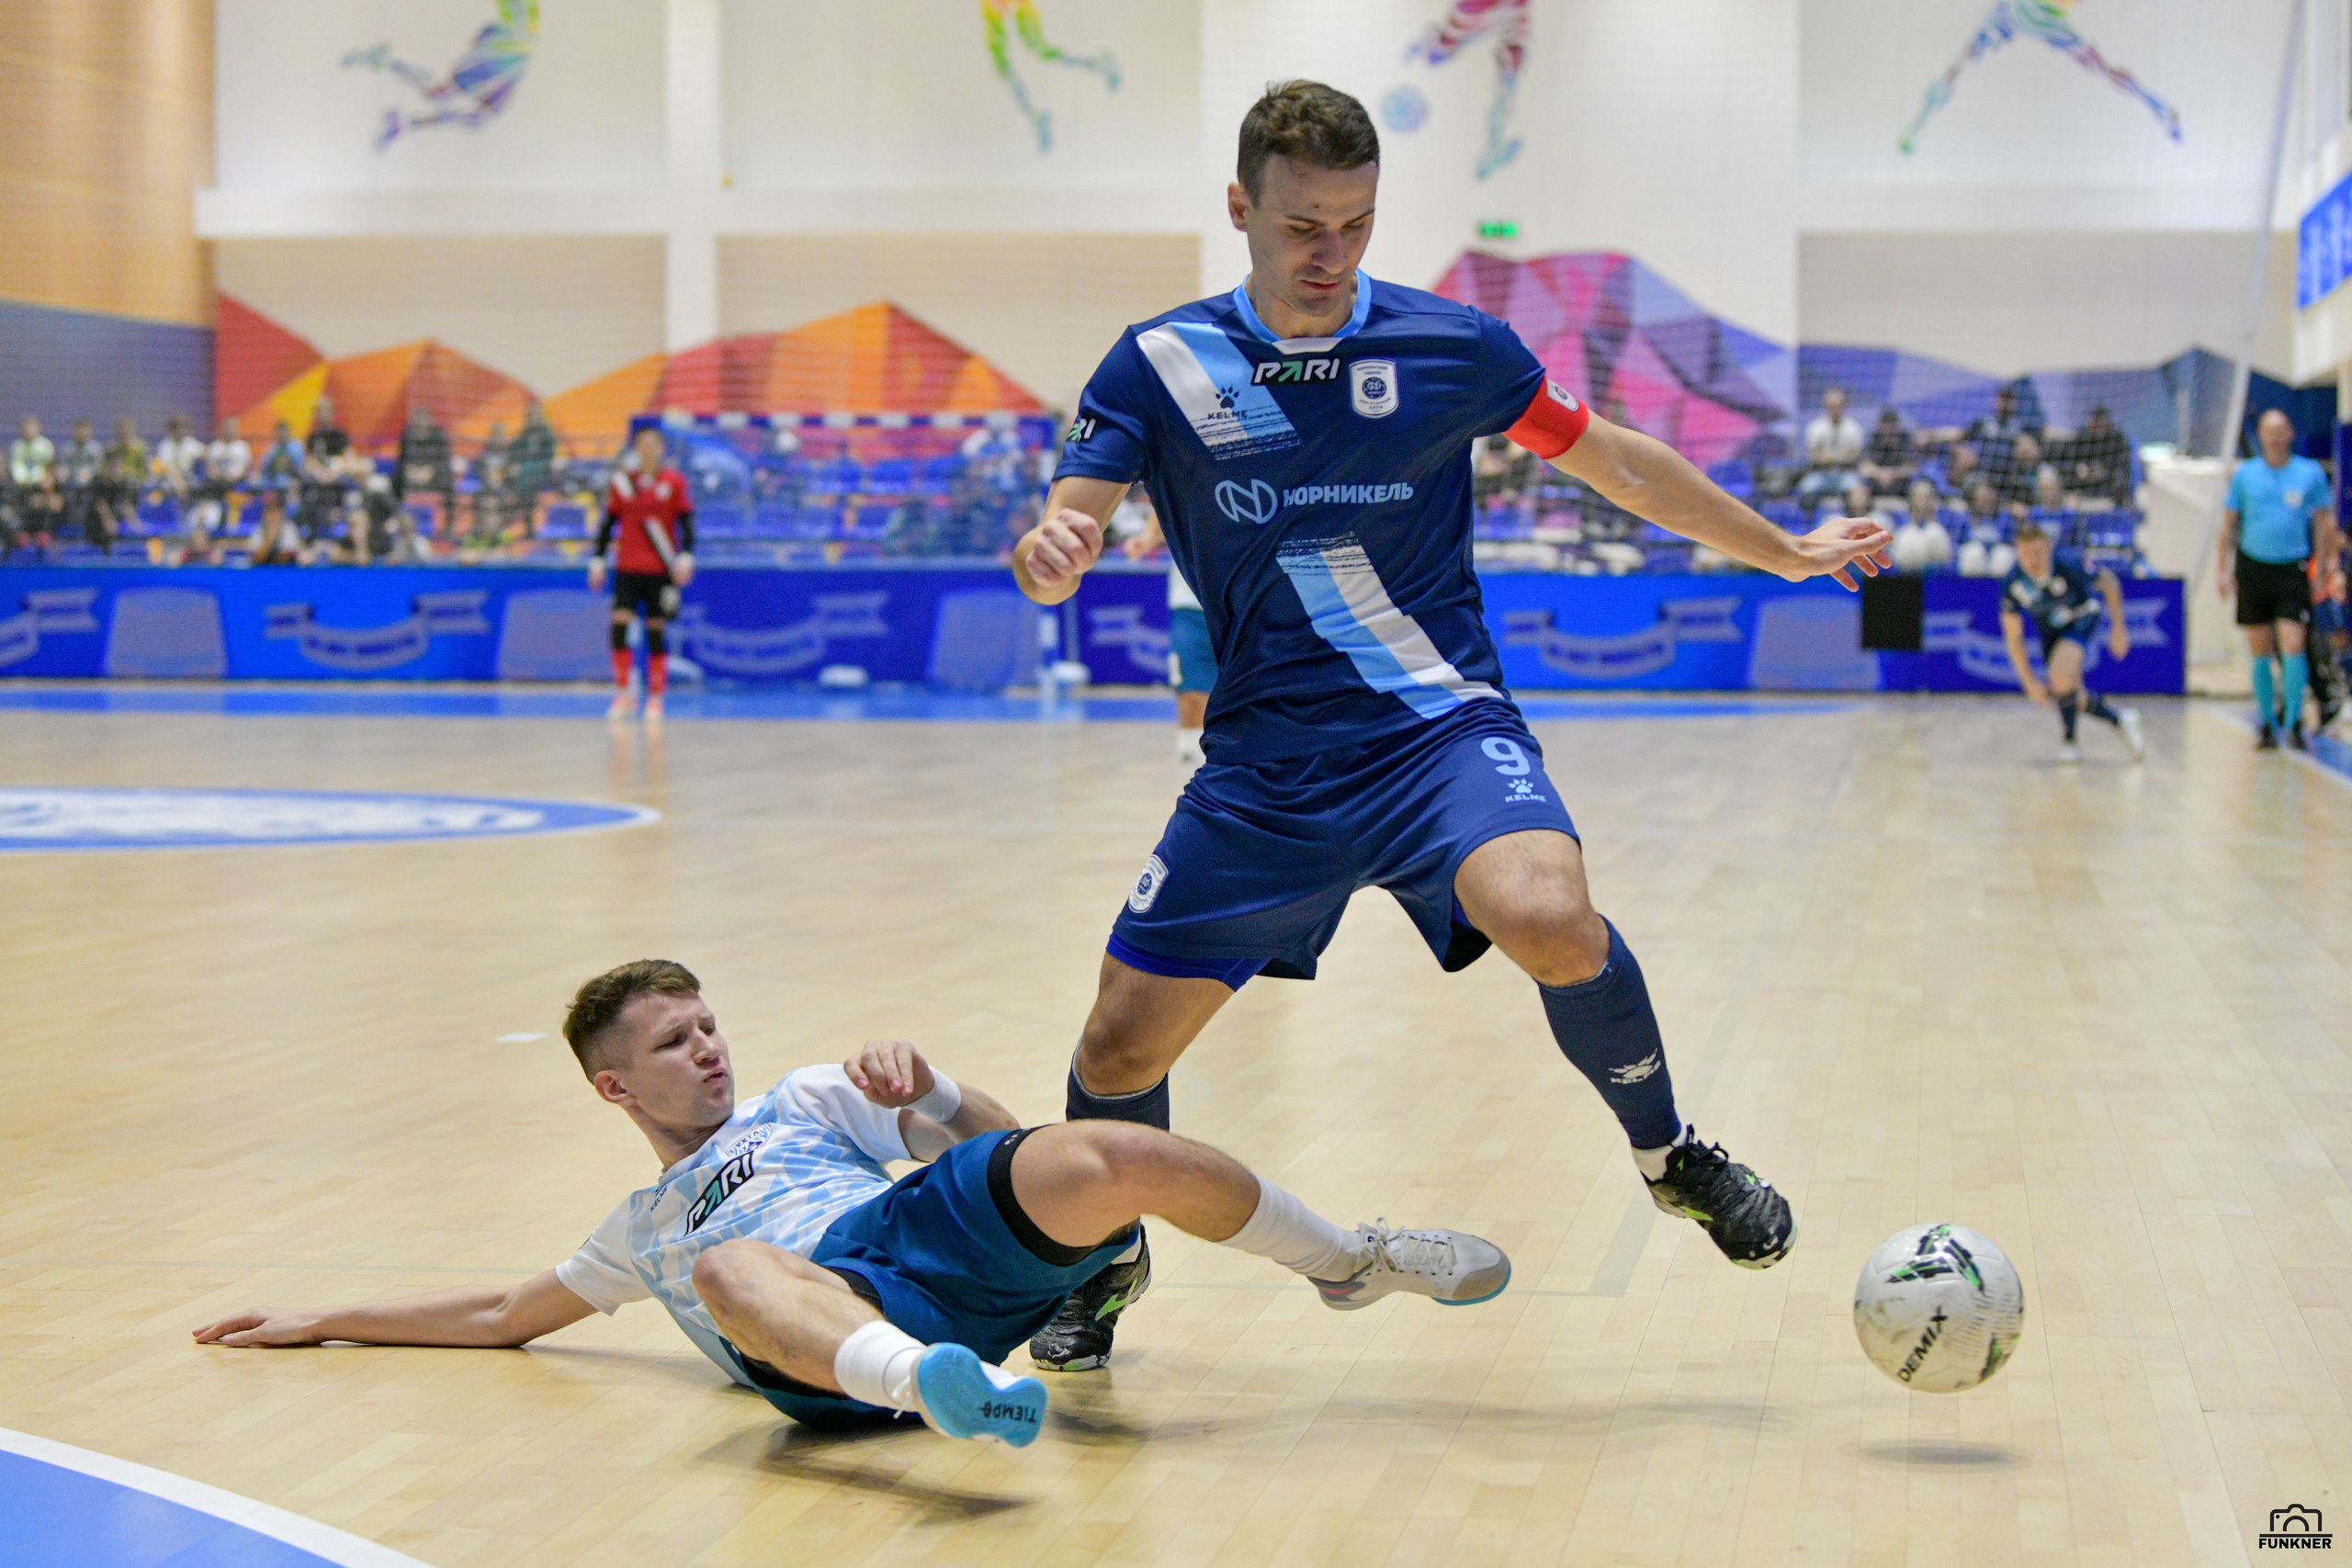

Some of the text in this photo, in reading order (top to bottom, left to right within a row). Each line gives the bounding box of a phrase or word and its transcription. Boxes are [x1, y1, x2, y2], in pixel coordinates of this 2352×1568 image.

[1253, 357, 1341, 385] PARI
[1207, 410, 1248, 420] KELME
[1283, 481, 1414, 507] НОРНИКЕЛЬ
[1480, 736, 1531, 776] 9
[1505, 794, 1546, 803] KELME
[686, 1154, 753, 1234] PARI
[1897, 1304, 1949, 1382] DEMIX
